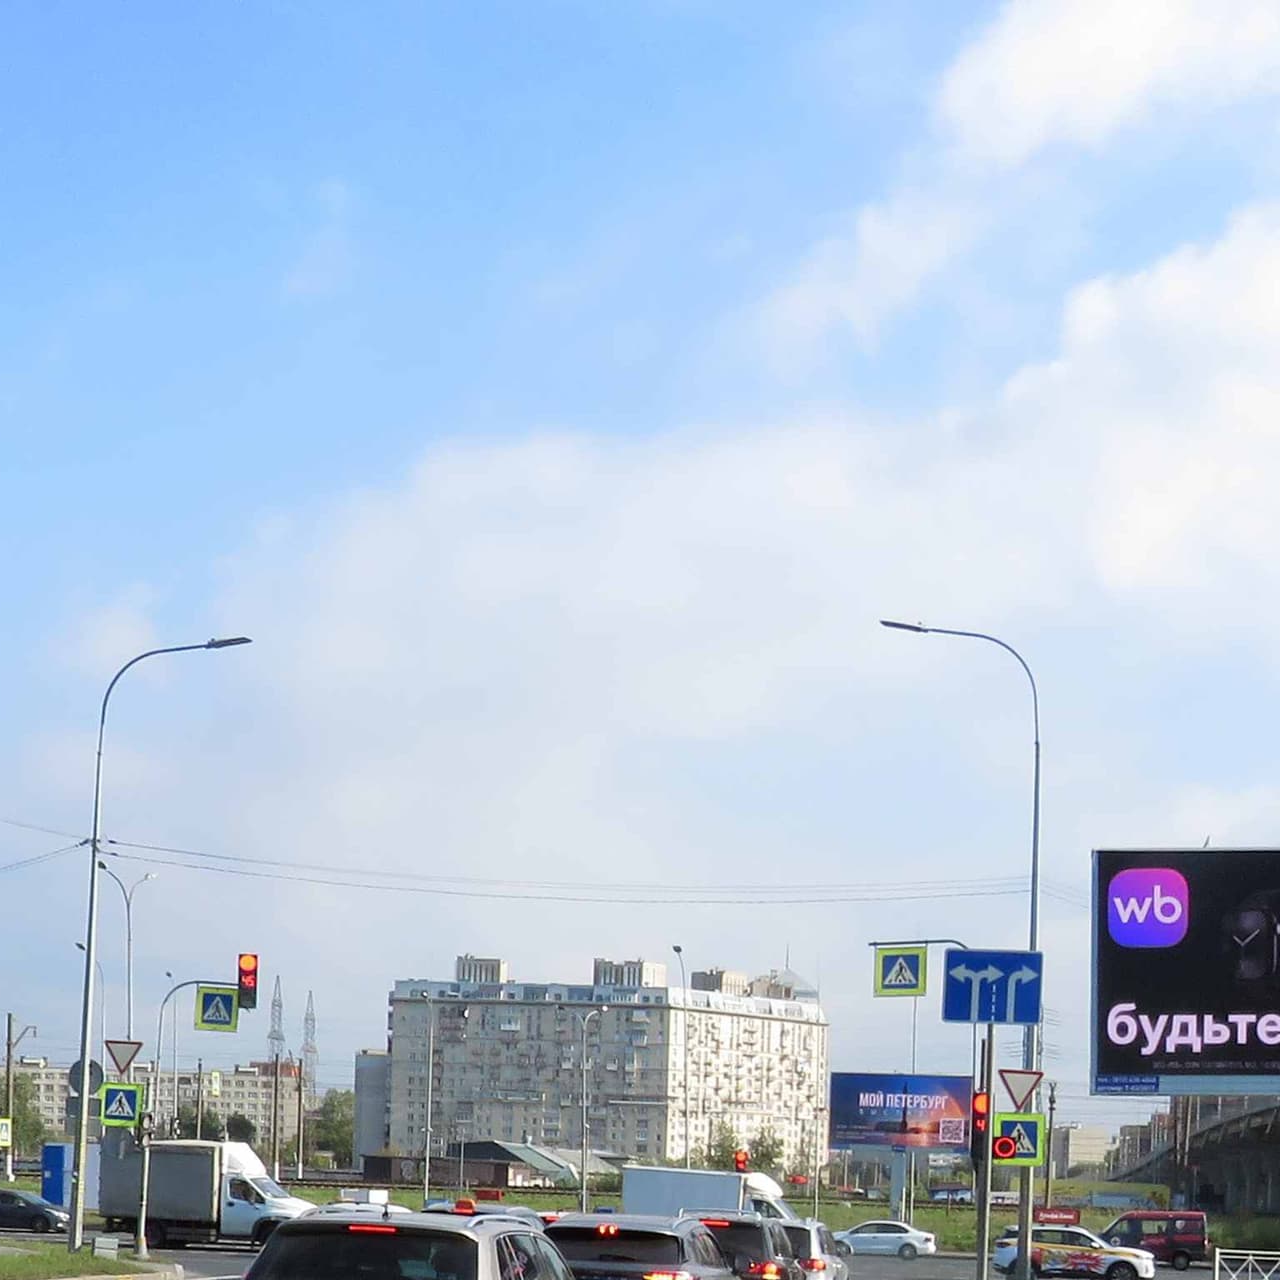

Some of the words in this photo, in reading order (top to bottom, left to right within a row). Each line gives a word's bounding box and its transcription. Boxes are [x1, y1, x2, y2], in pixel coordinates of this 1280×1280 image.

[1113, 885, 1183, 924] wb
[859, 1091, 884, 1108] МОЙ
[886, 1093, 948, 1109] ПЕТЕРБУРГ
